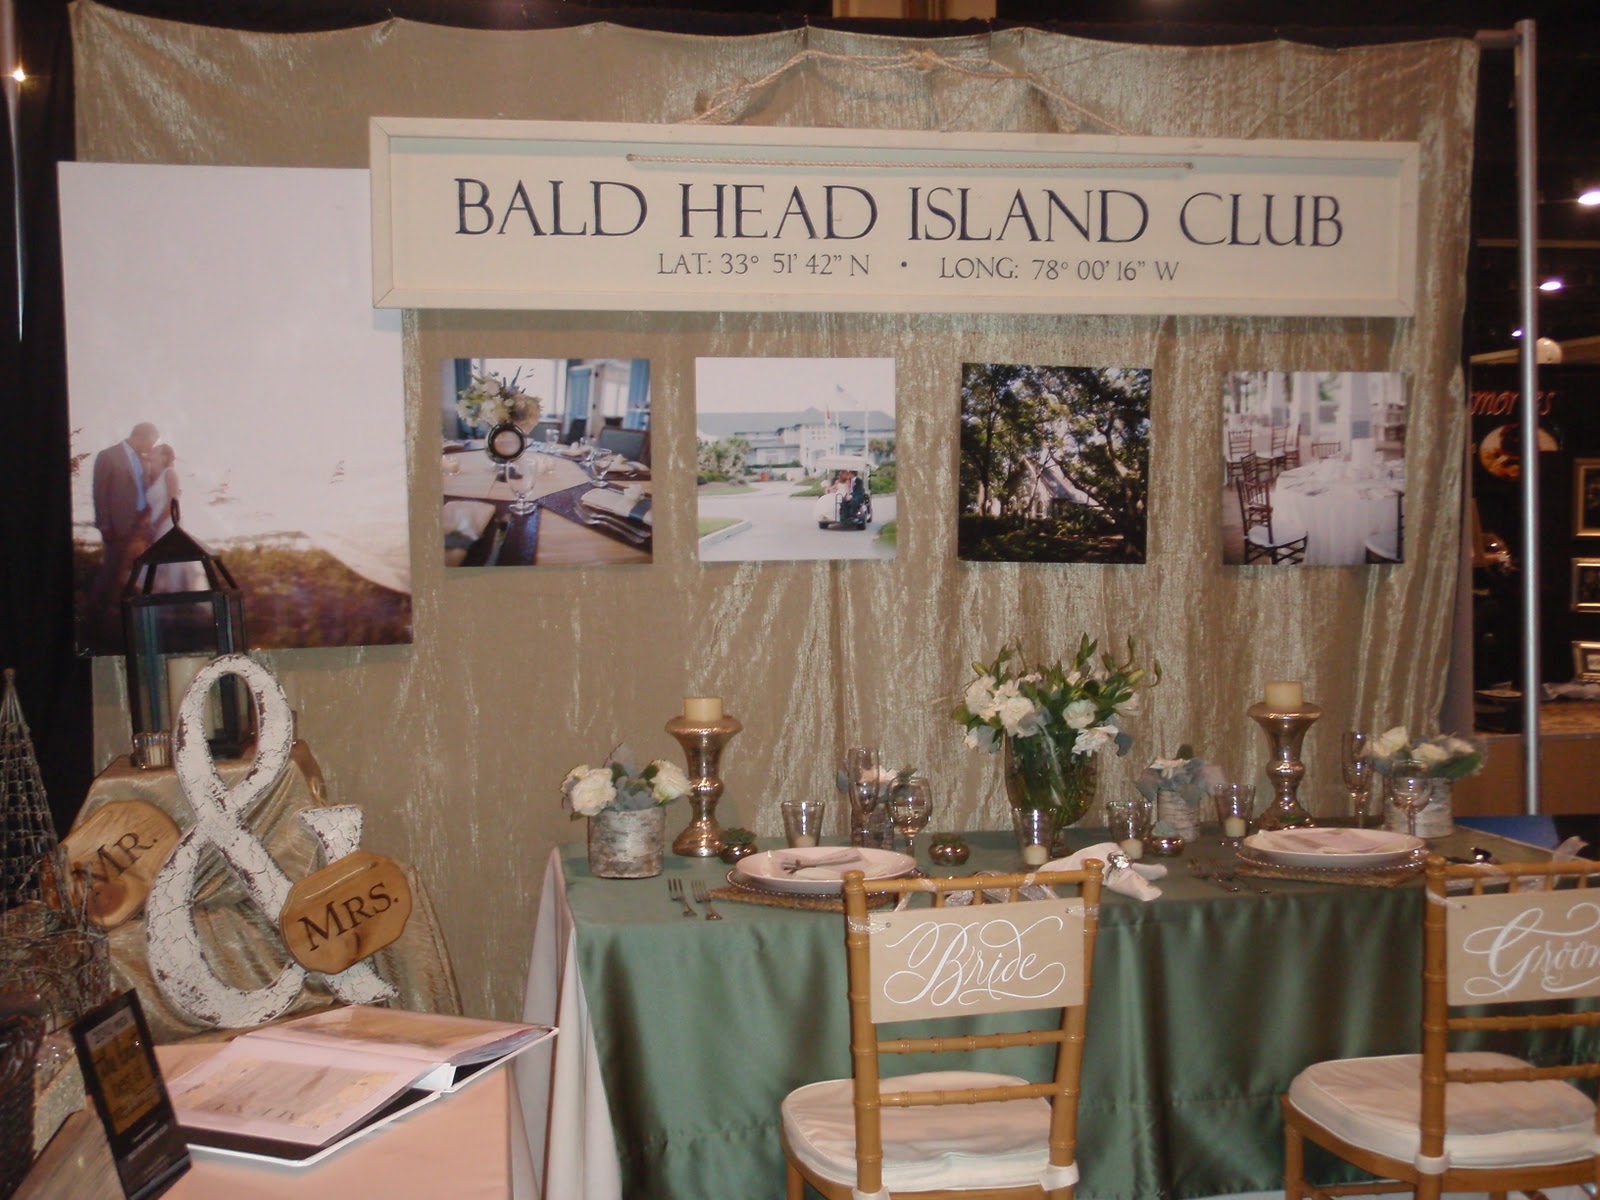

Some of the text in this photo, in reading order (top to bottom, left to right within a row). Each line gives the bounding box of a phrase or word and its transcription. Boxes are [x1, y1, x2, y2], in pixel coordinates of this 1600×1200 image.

[453, 177, 1344, 248] BALD HEAD ISLAND CLUB
[657, 252, 713, 275] LAT:
[720, 252, 760, 275] 33°
[849, 254, 871, 277] N
[938, 256, 1019, 280] LONG:
[1031, 258, 1069, 281] 78°
[1153, 260, 1180, 281] W
[71, 832, 159, 884] MR.
[146, 653, 396, 1030] &
[296, 881, 400, 953] MRS.
[883, 915, 1066, 1006] Bride
